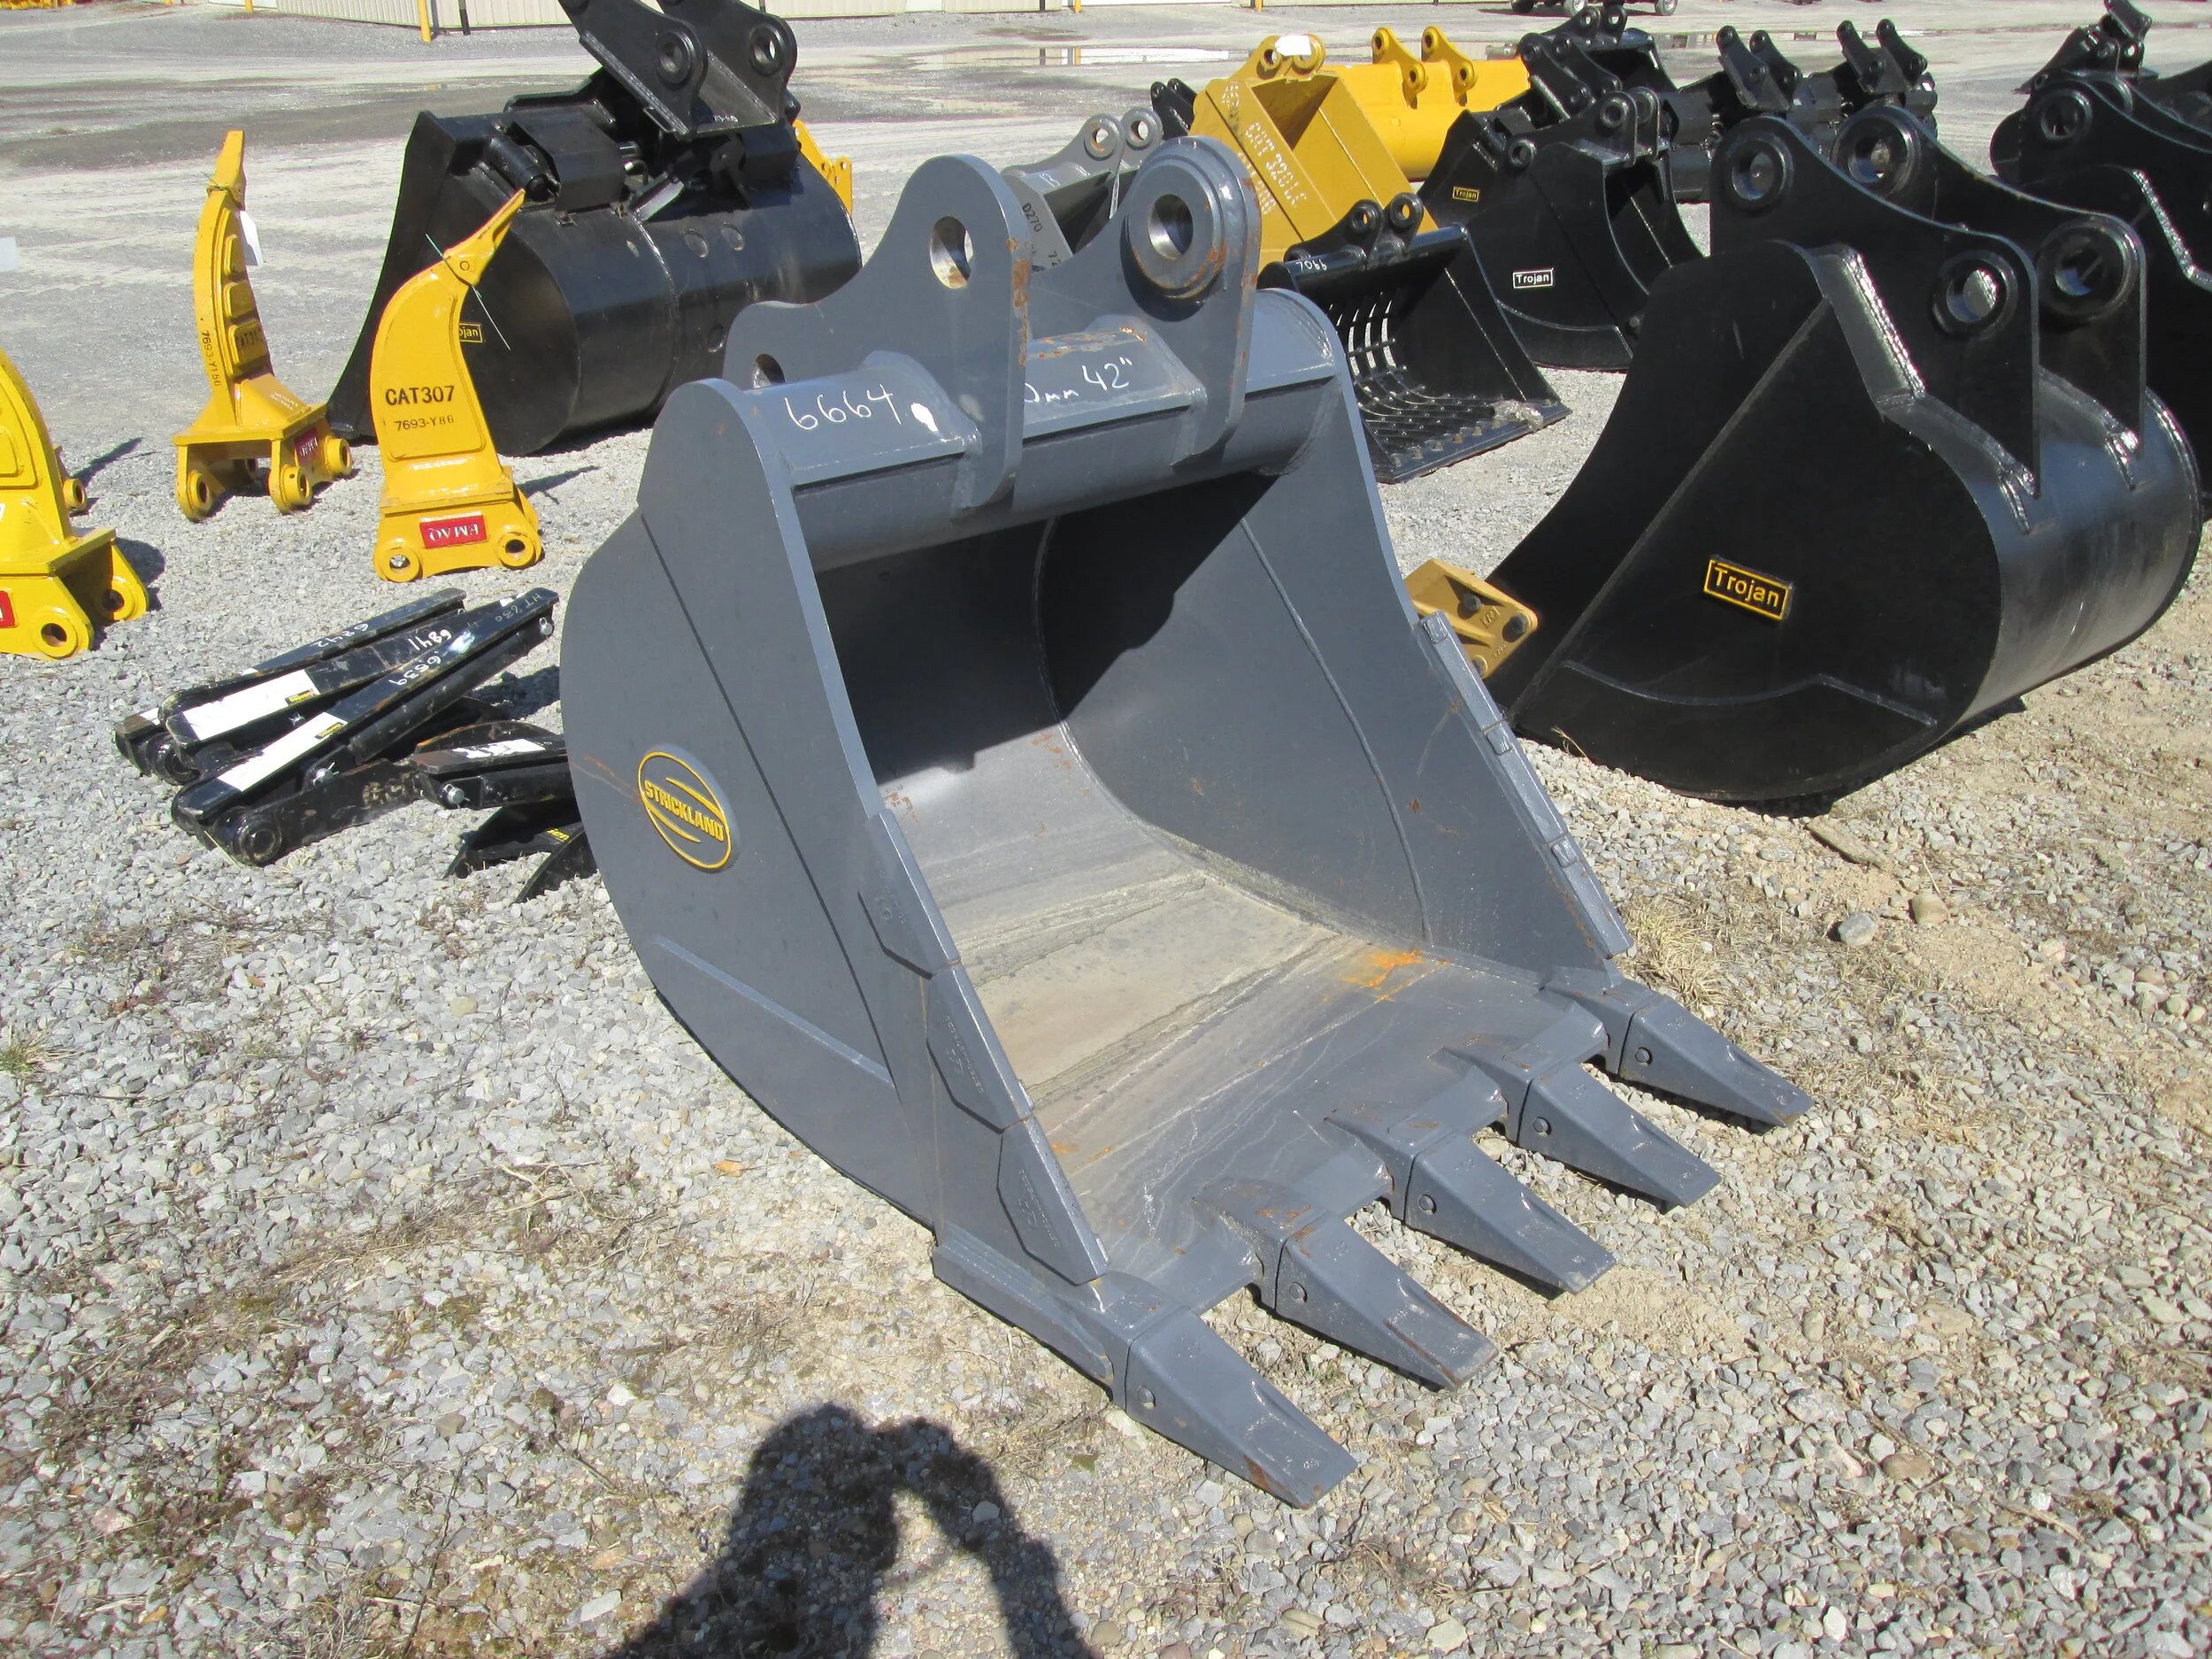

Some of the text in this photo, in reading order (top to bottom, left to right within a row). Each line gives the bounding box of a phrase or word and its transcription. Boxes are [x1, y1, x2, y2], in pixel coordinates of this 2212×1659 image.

[1455, 189, 1477, 200] Trojan
[1022, 203, 1043, 232] D270
[1294, 258, 1327, 272] 7066
[1516, 273, 1550, 285] Trojan
[385, 385, 455, 406] CAT307
[784, 382, 902, 431] 6664
[394, 414, 454, 432] 7693-Y86
[427, 523, 480, 542] EMAQ
[1714, 566, 1780, 608] Trojan
[407, 628, 454, 652] 6841
[643, 780, 726, 842] STRICKLAND
